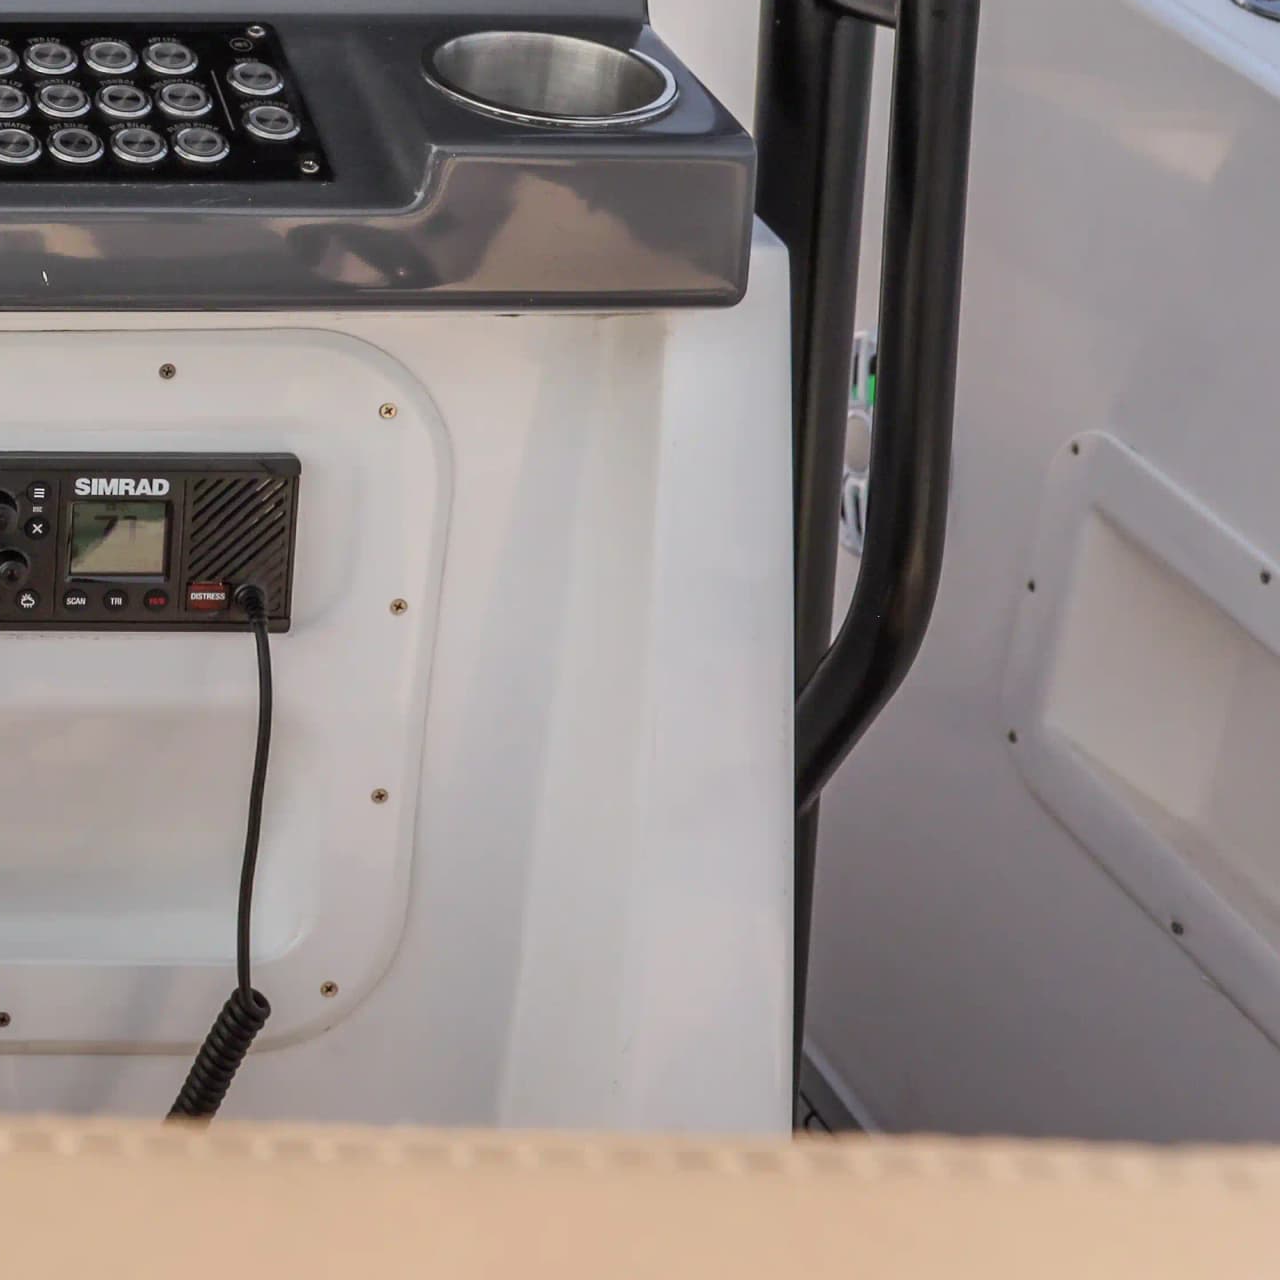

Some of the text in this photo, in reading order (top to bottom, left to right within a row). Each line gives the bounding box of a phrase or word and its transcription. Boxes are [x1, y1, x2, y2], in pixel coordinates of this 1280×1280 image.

[74, 477, 170, 496] SIMRAD
[190, 592, 226, 601] DISTRESS
[66, 597, 86, 605] SCAN
[110, 597, 123, 605] TRI
